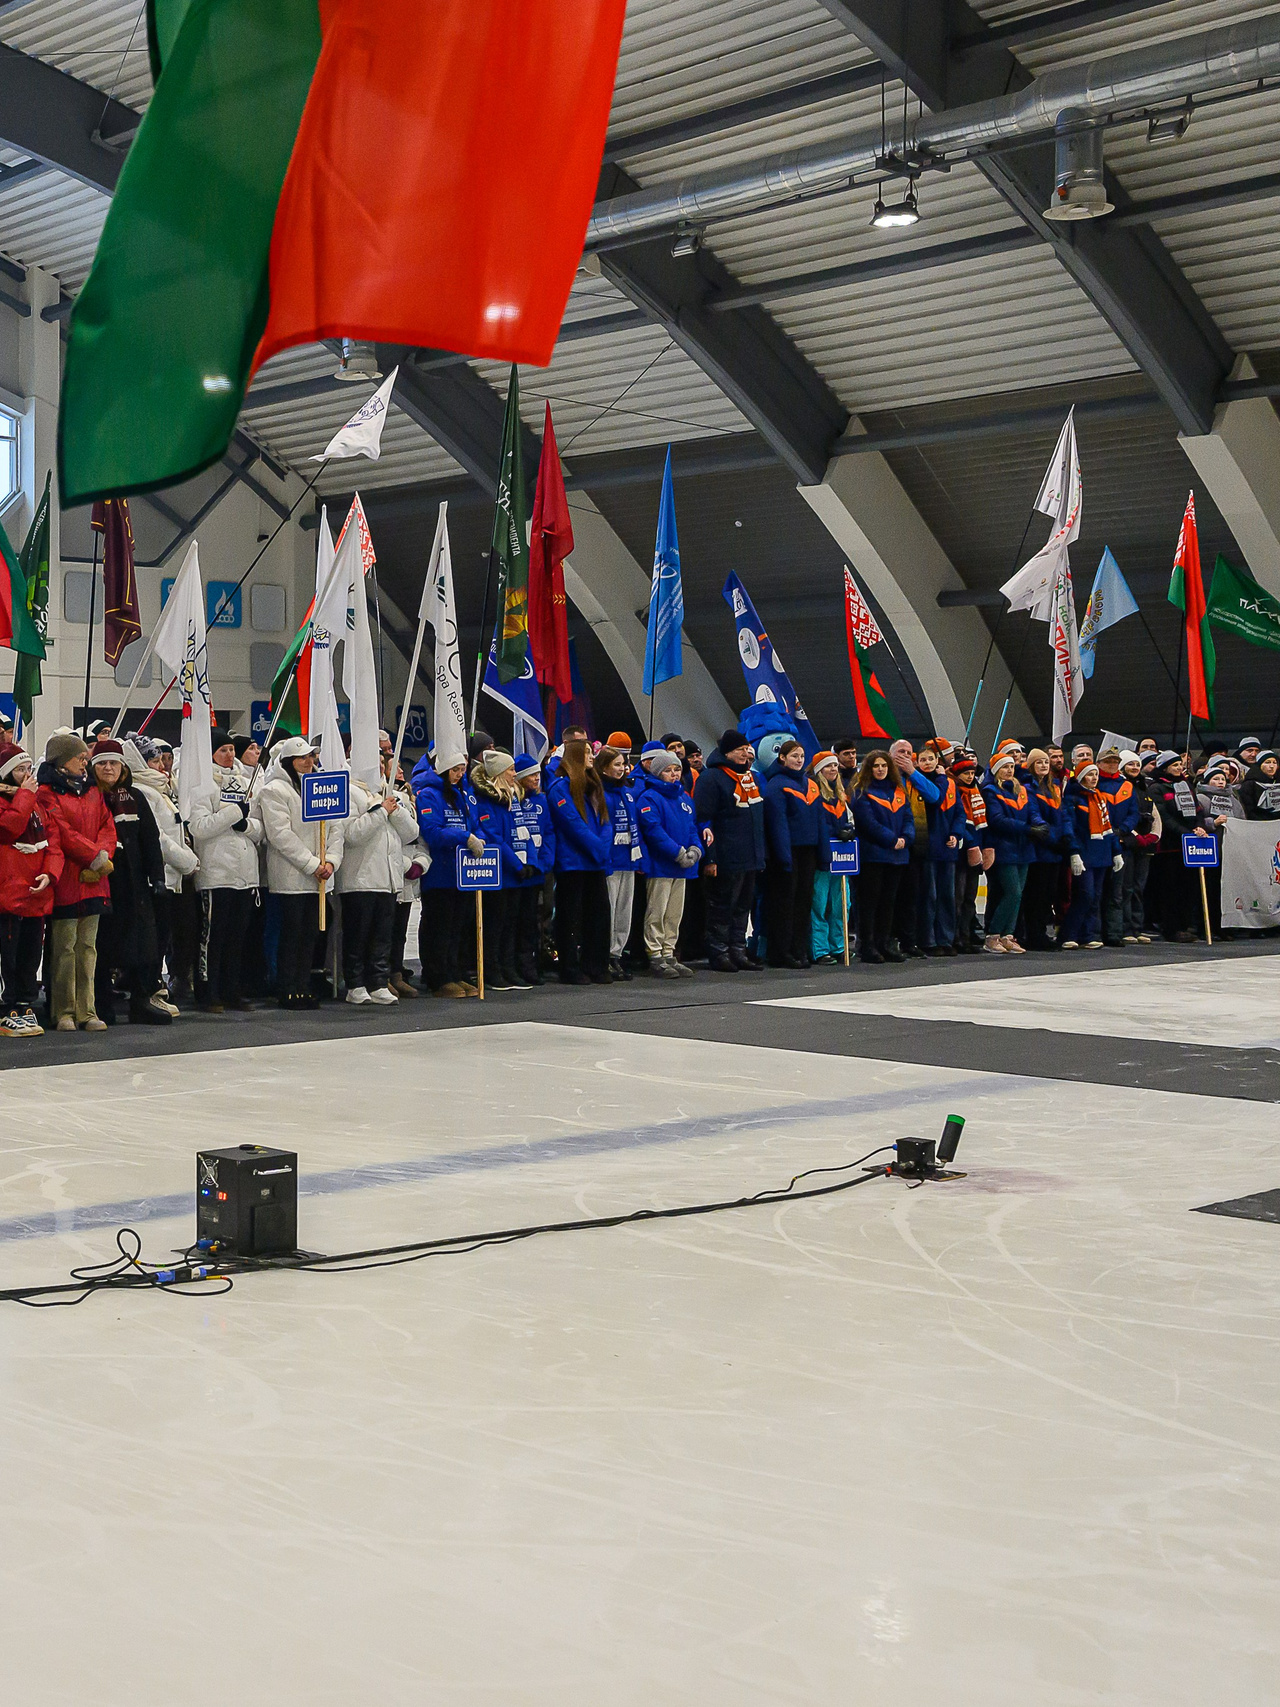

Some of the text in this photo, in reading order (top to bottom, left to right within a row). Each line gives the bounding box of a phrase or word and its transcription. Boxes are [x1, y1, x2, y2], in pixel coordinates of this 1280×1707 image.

[436, 664, 450, 689] Spa
[312, 782, 339, 795] Белые
[311, 797, 340, 811] тигры
[462, 855, 497, 867] Академия
[466, 868, 493, 880] сервиса
